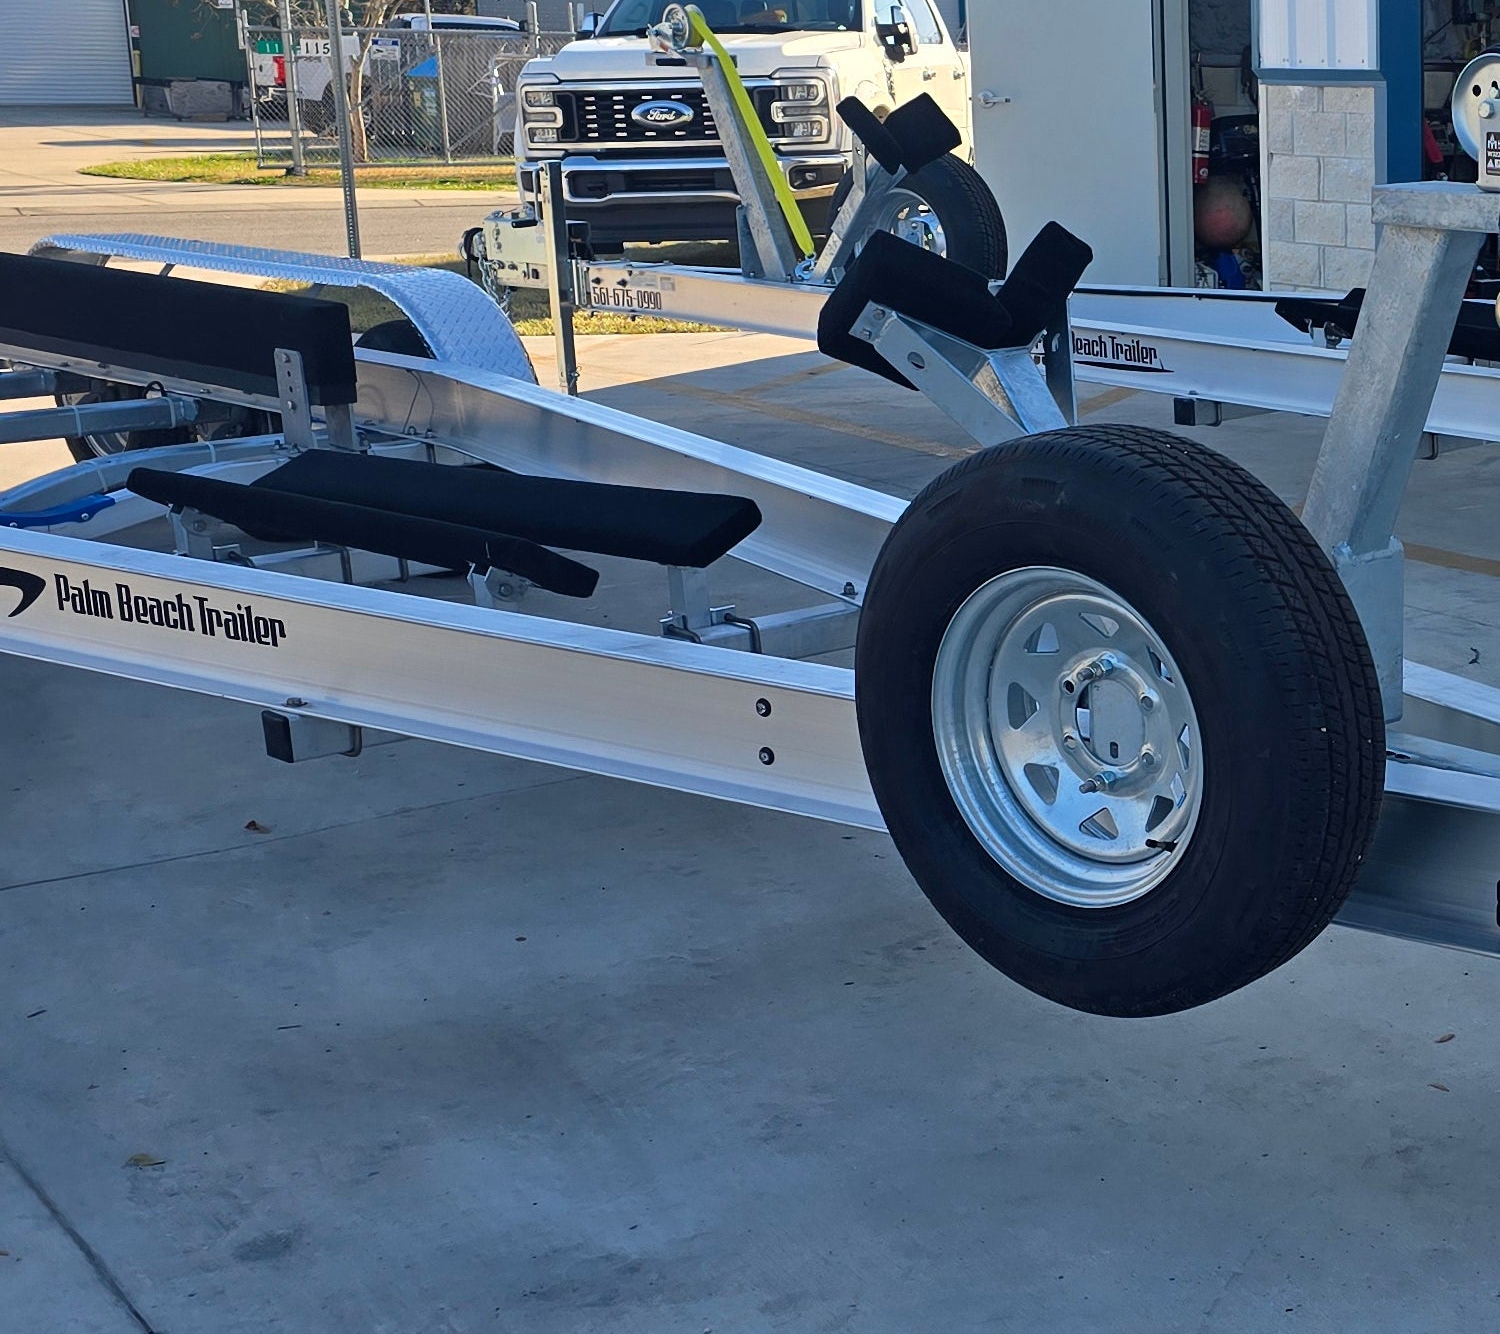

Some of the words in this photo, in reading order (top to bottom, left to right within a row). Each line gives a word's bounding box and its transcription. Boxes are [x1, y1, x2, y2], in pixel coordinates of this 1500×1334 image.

[304, 41, 331, 55] 115
[646, 108, 676, 121] Ford
[591, 286, 662, 310] 561-675-0990
[1108, 335, 1158, 365] Trailer
[53, 573, 114, 620] Palm
[115, 582, 196, 633] Beach
[192, 595, 287, 648] Trailer
